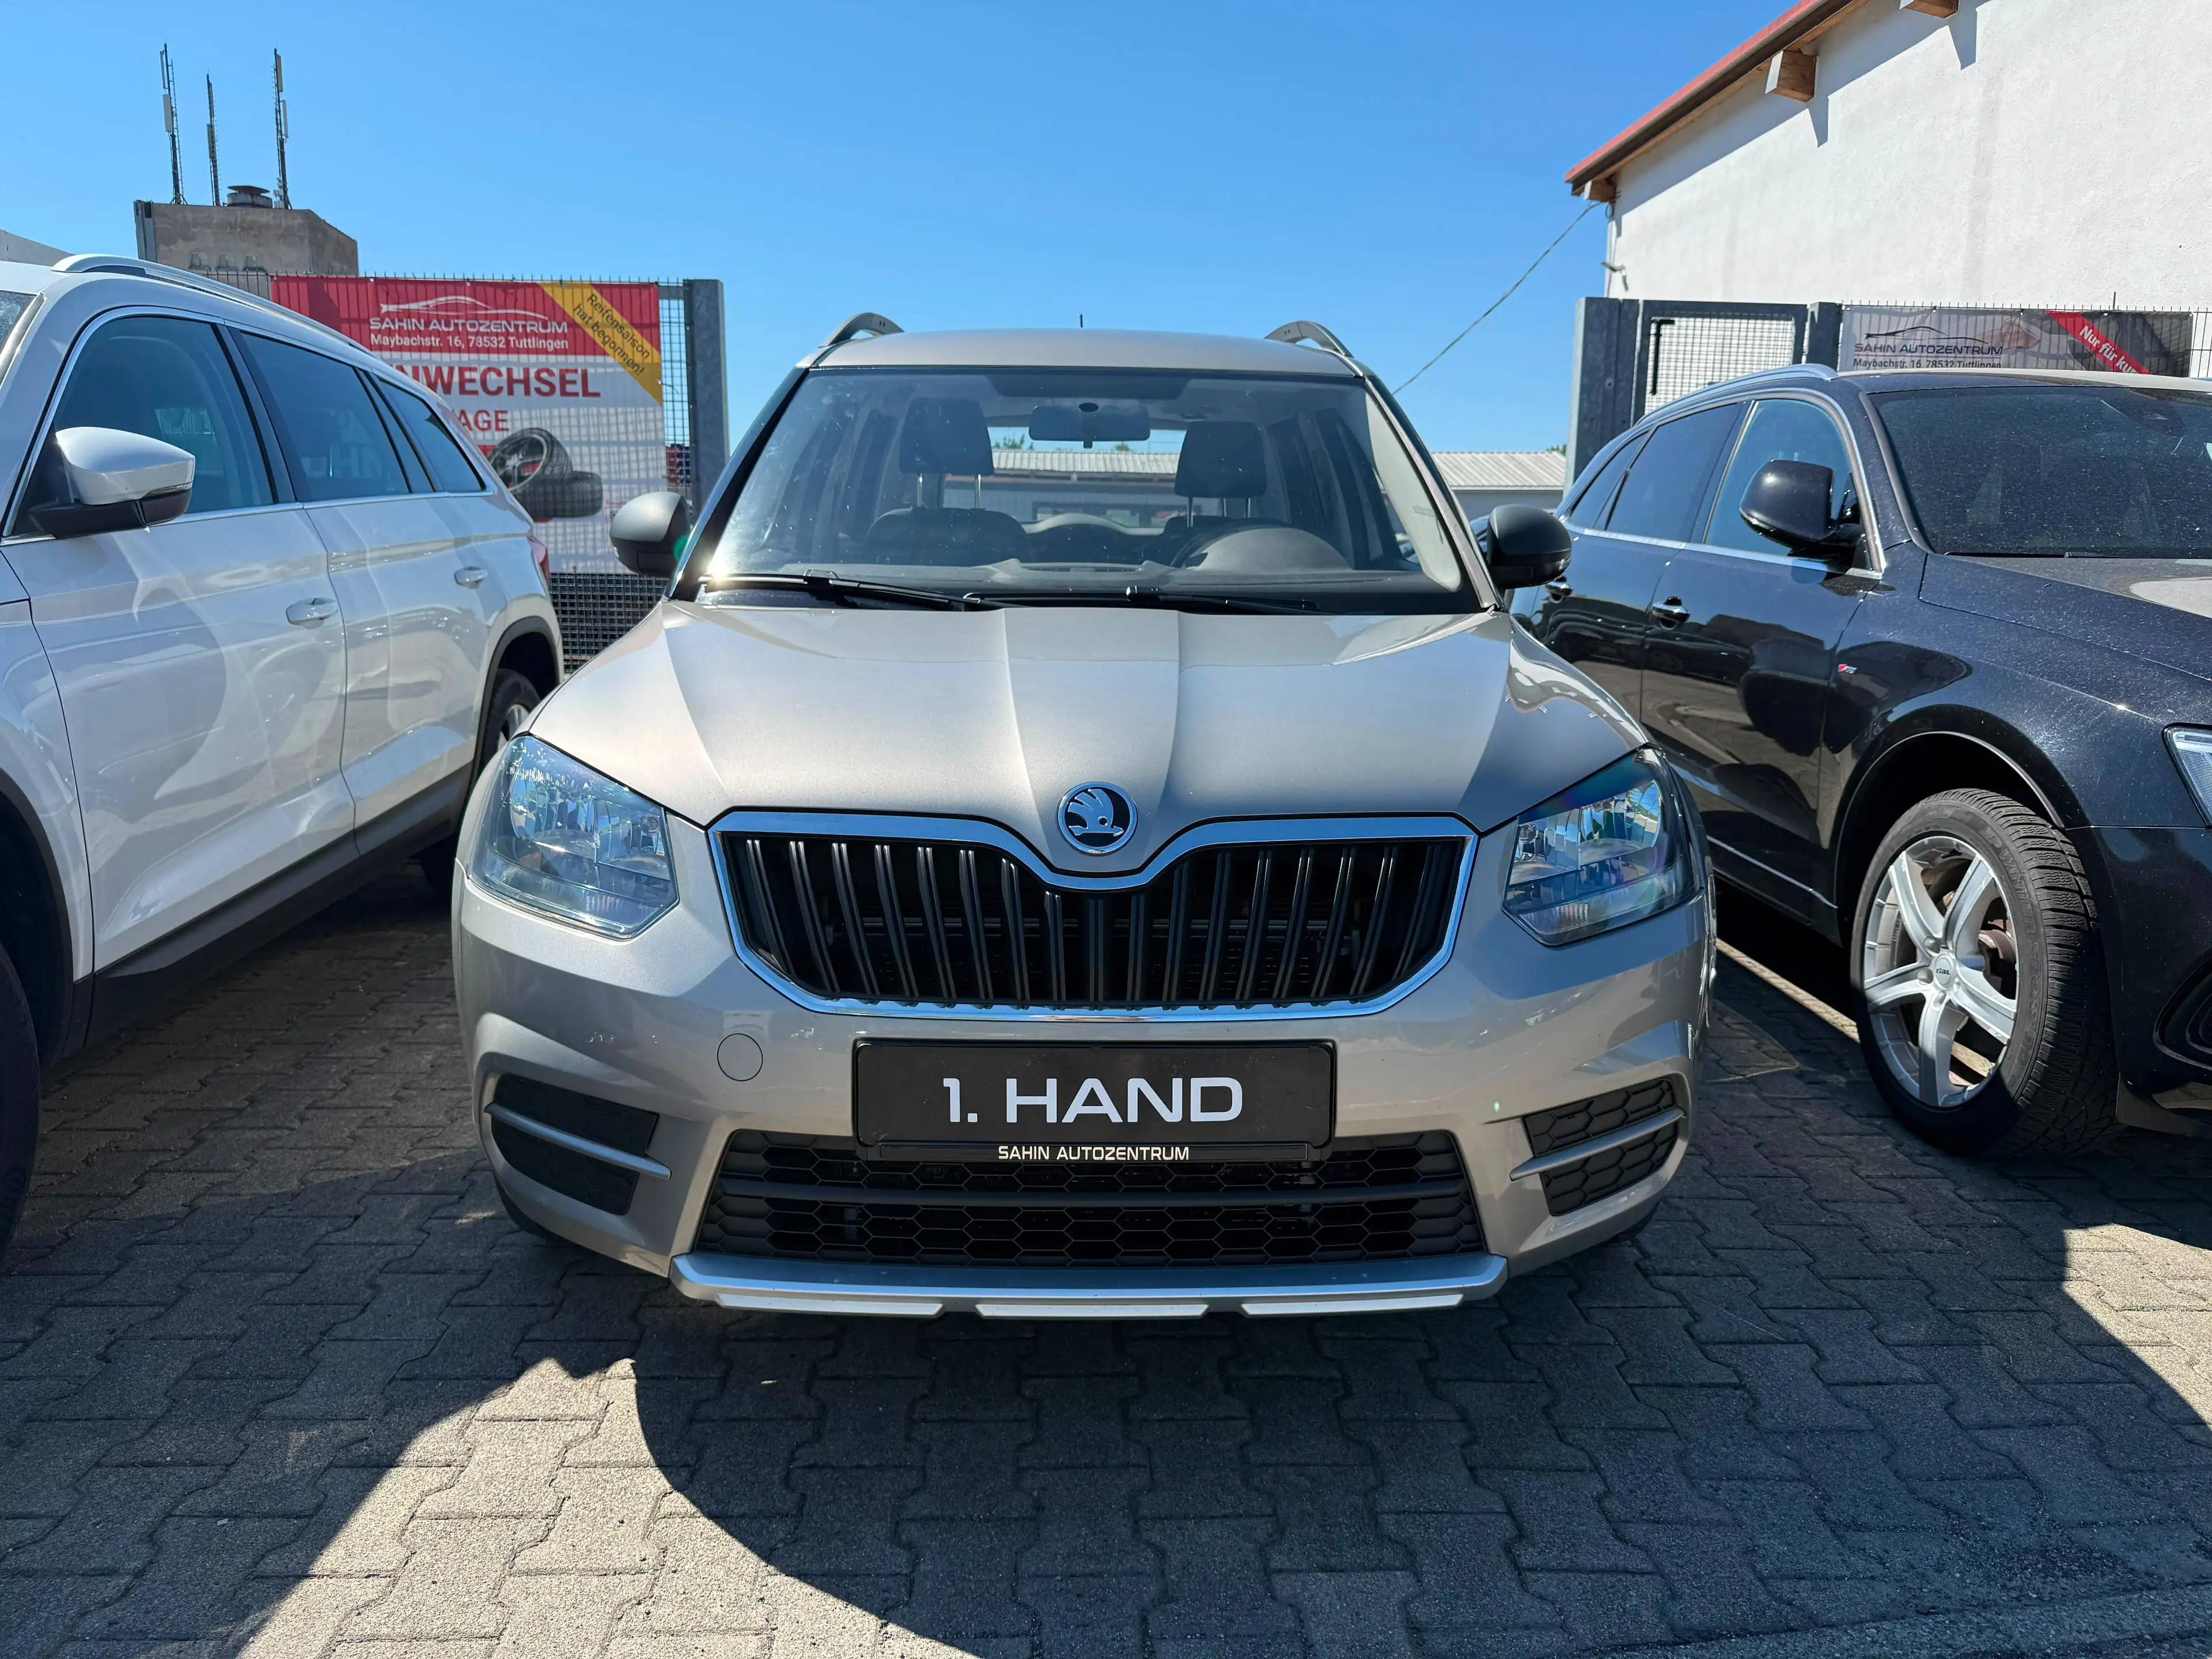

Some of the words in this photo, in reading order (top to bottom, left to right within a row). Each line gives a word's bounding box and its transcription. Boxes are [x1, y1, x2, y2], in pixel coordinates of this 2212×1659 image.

[370, 317, 425, 331] SAHIN
[429, 319, 568, 334] AUTOZENTRUM
[587, 293, 650, 359] Reifensaison
[370, 334, 442, 347] Maybachstr.
[447, 335, 465, 349] 16,
[468, 336, 506, 349] 78532
[509, 336, 569, 351] Tuttlingen
[574, 304, 592, 325] hat
[591, 321, 645, 376] begonnen!
[2079, 325, 2100, 347] Nur
[2099, 342, 2118, 361] für
[1854, 343, 1896, 353] SAHIN
[1899, 344, 2003, 355] AUTOZENTRUM
[1853, 358, 1907, 370] Maybachstr.
[1926, 359, 1954, 368] 78532
[1957, 360, 2001, 368] Tuttlingen
[943, 1078, 978, 1123] 1.
[1006, 1077, 1243, 1123] HAND
[998, 1145, 1050, 1161] SAHIN
[1056, 1145, 1189, 1161] AUTOZENTRUM
